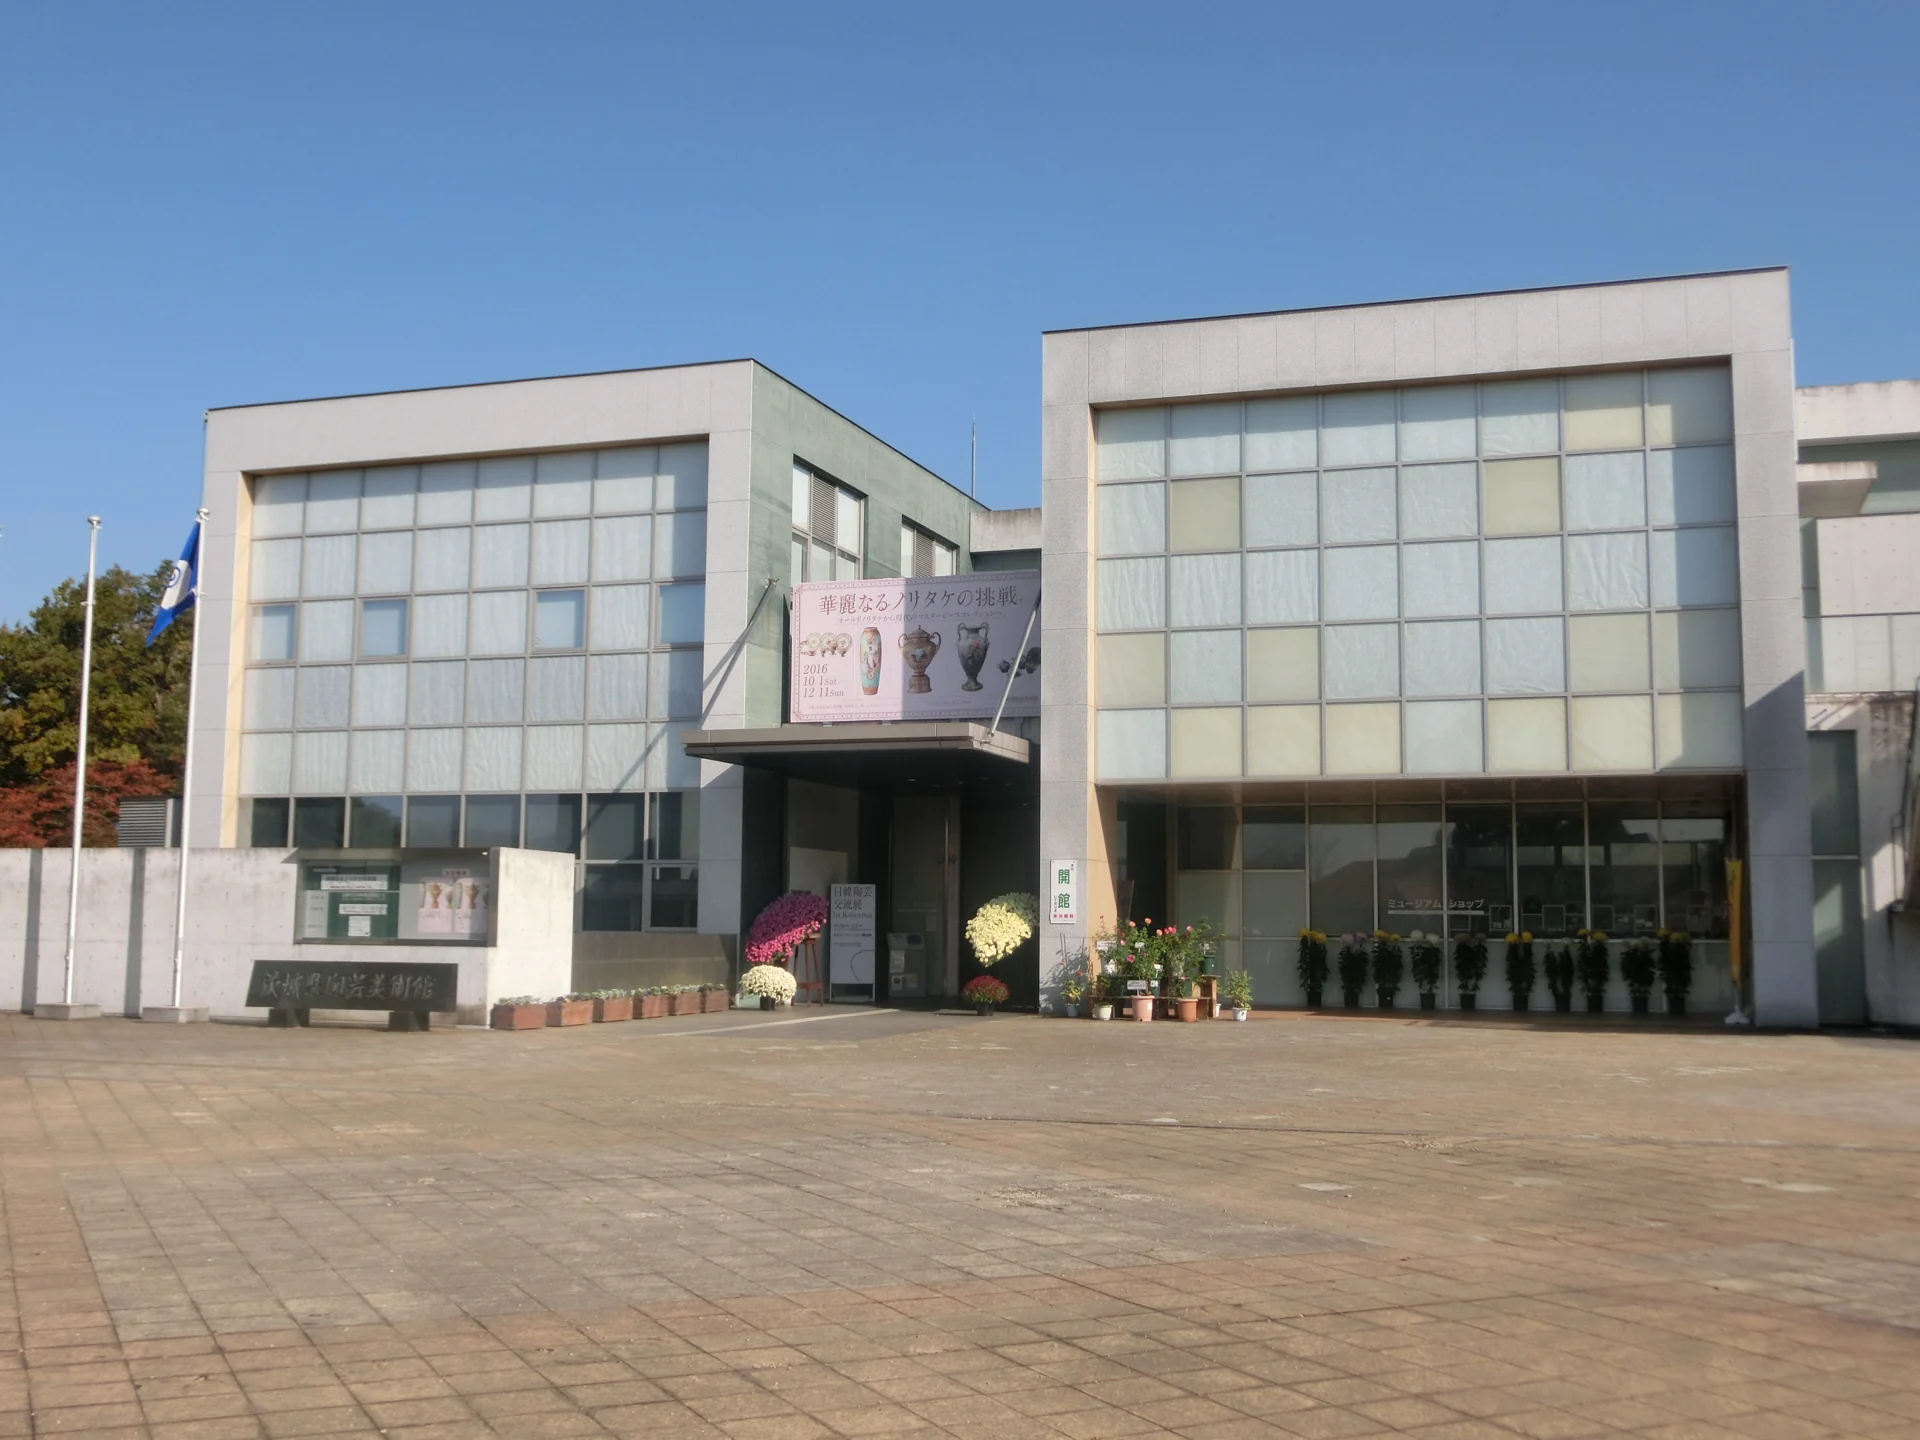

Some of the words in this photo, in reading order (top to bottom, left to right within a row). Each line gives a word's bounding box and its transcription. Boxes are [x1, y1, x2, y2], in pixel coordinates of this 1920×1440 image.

[819, 585, 1017, 614] 華麗なるノリタケの挑戦
[803, 664, 828, 674] 2016
[804, 676, 815, 686] 10
[804, 687, 815, 698] 12
[834, 886, 873, 898] 日韓陶芸
[1058, 869, 1070, 908] 開館
[834, 898, 862, 910] 交流展
[1388, 899, 1442, 909] ミュージアム
[1449, 899, 1484, 909] ショップ
